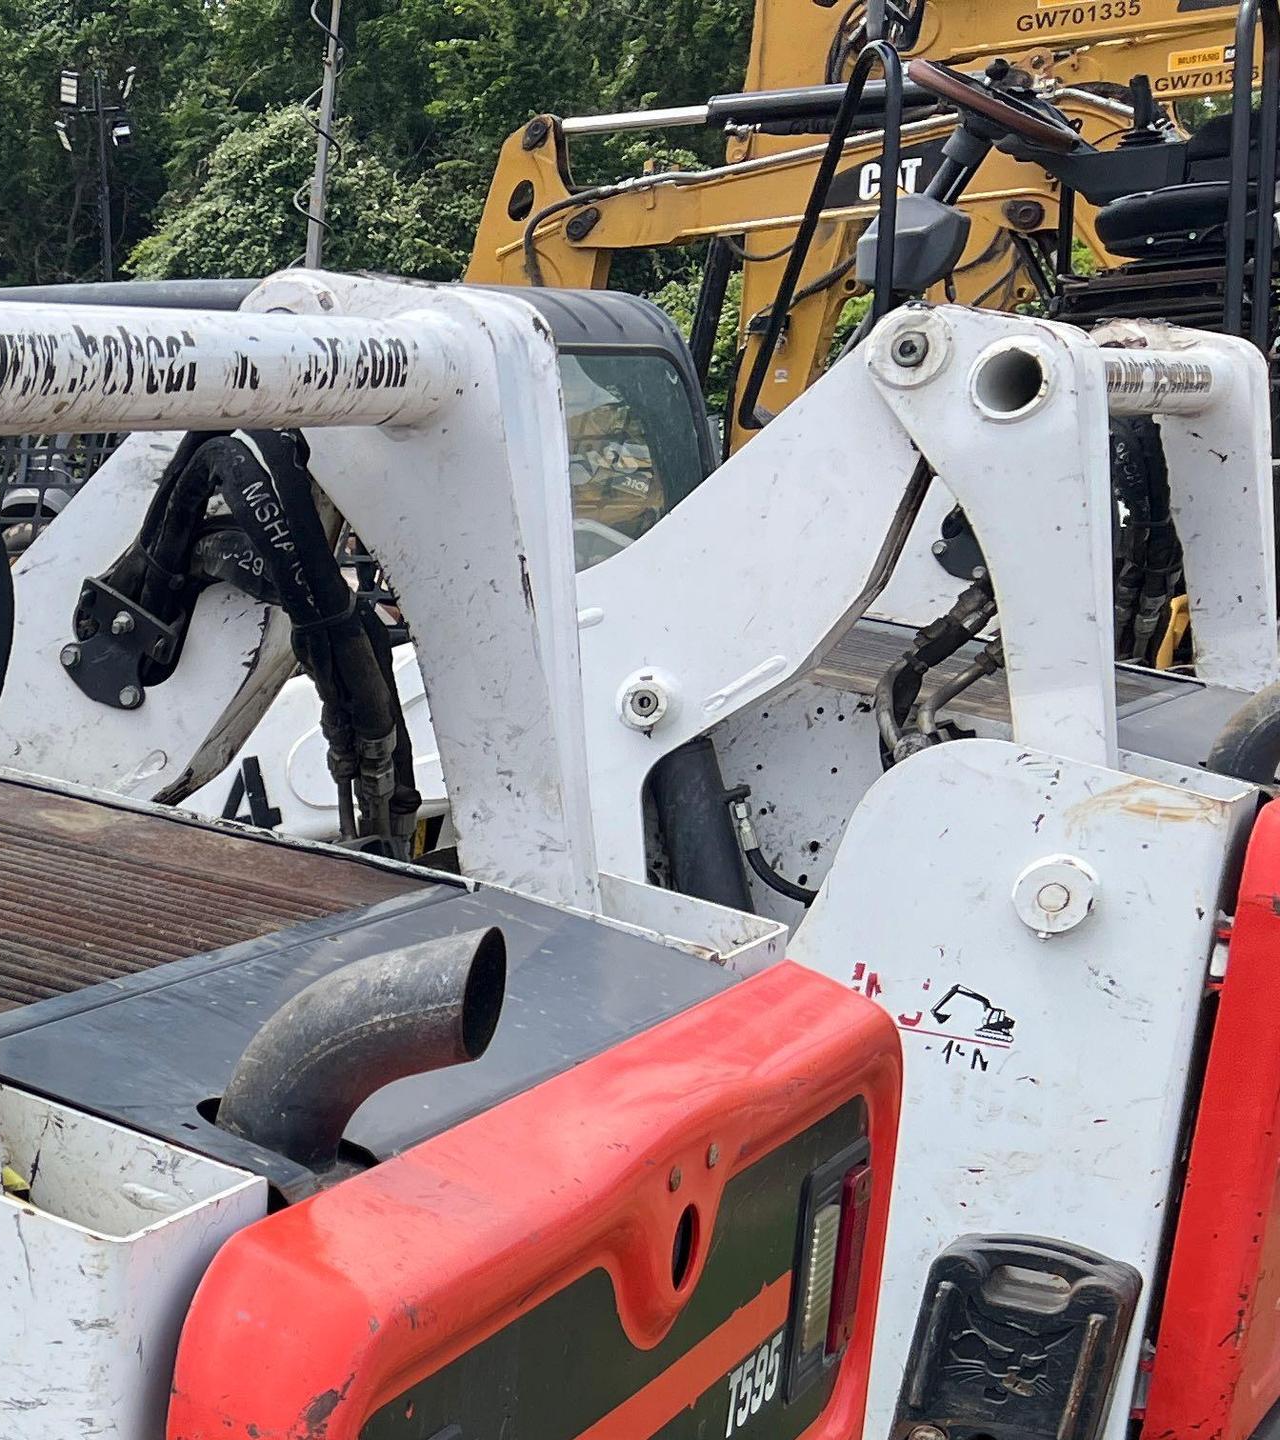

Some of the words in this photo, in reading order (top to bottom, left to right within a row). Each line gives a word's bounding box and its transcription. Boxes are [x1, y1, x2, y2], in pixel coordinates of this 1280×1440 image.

[1016, 1, 1141, 32] GW701335
[1177, 52, 1220, 65] MUSTANG
[1154, 66, 1260, 92] GW70135
[859, 157, 923, 201] CT
[725, 1330, 784, 1439] T595
